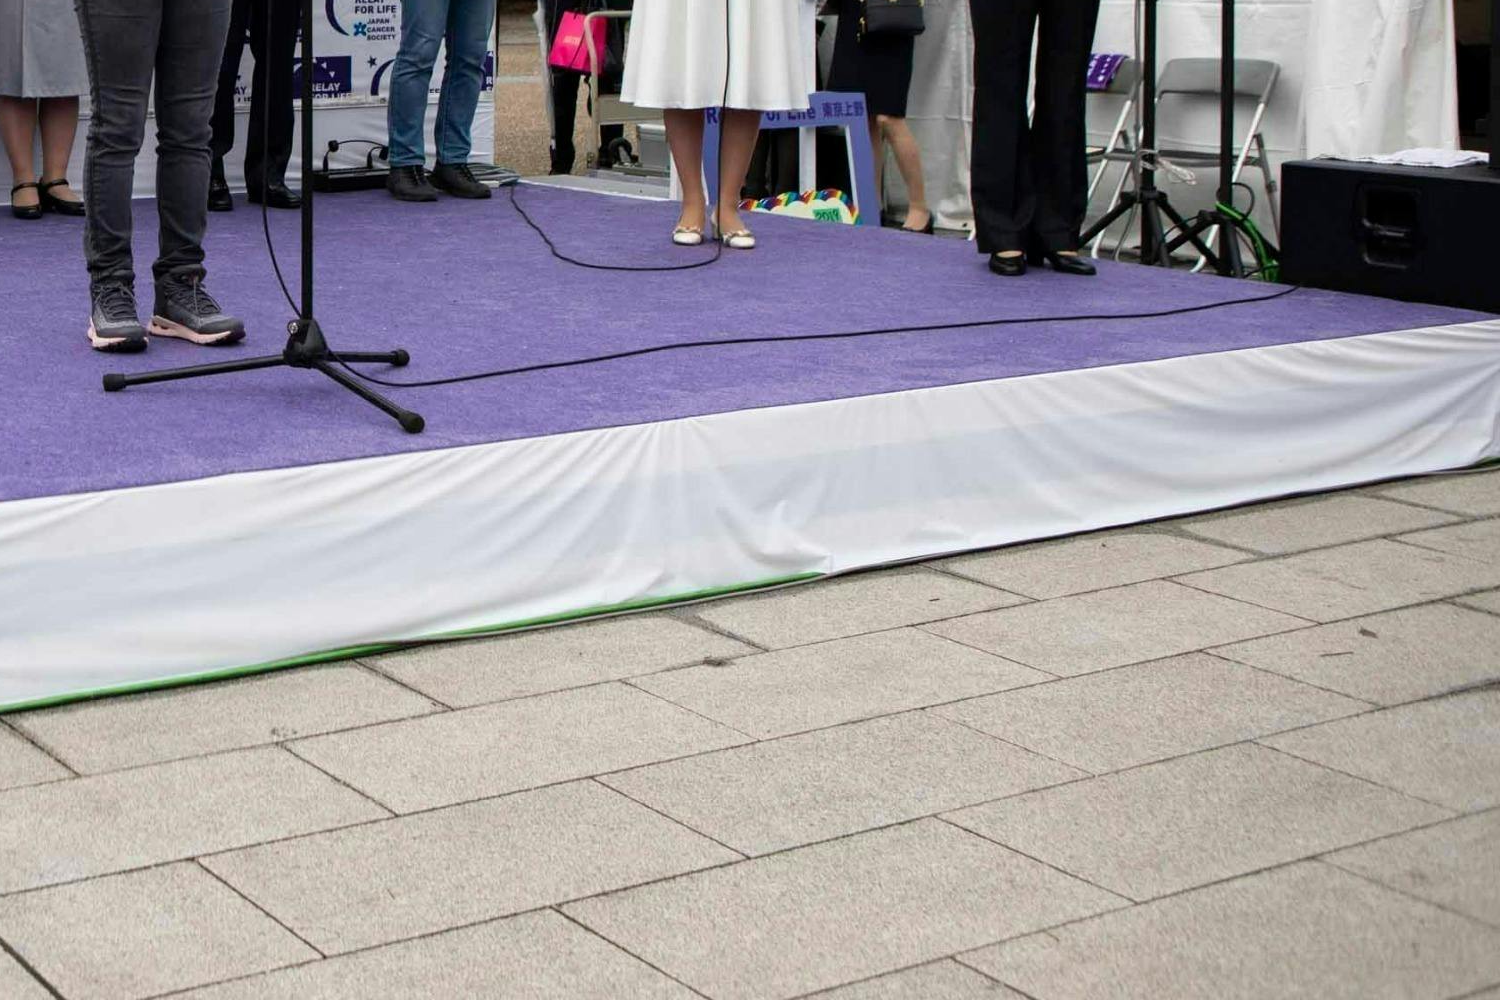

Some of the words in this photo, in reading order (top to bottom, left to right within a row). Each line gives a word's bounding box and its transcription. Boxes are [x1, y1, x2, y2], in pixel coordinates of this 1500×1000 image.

[354, 5, 374, 14] FOR
[377, 5, 397, 14] LIFE
[822, 102, 865, 118] 東京上野
